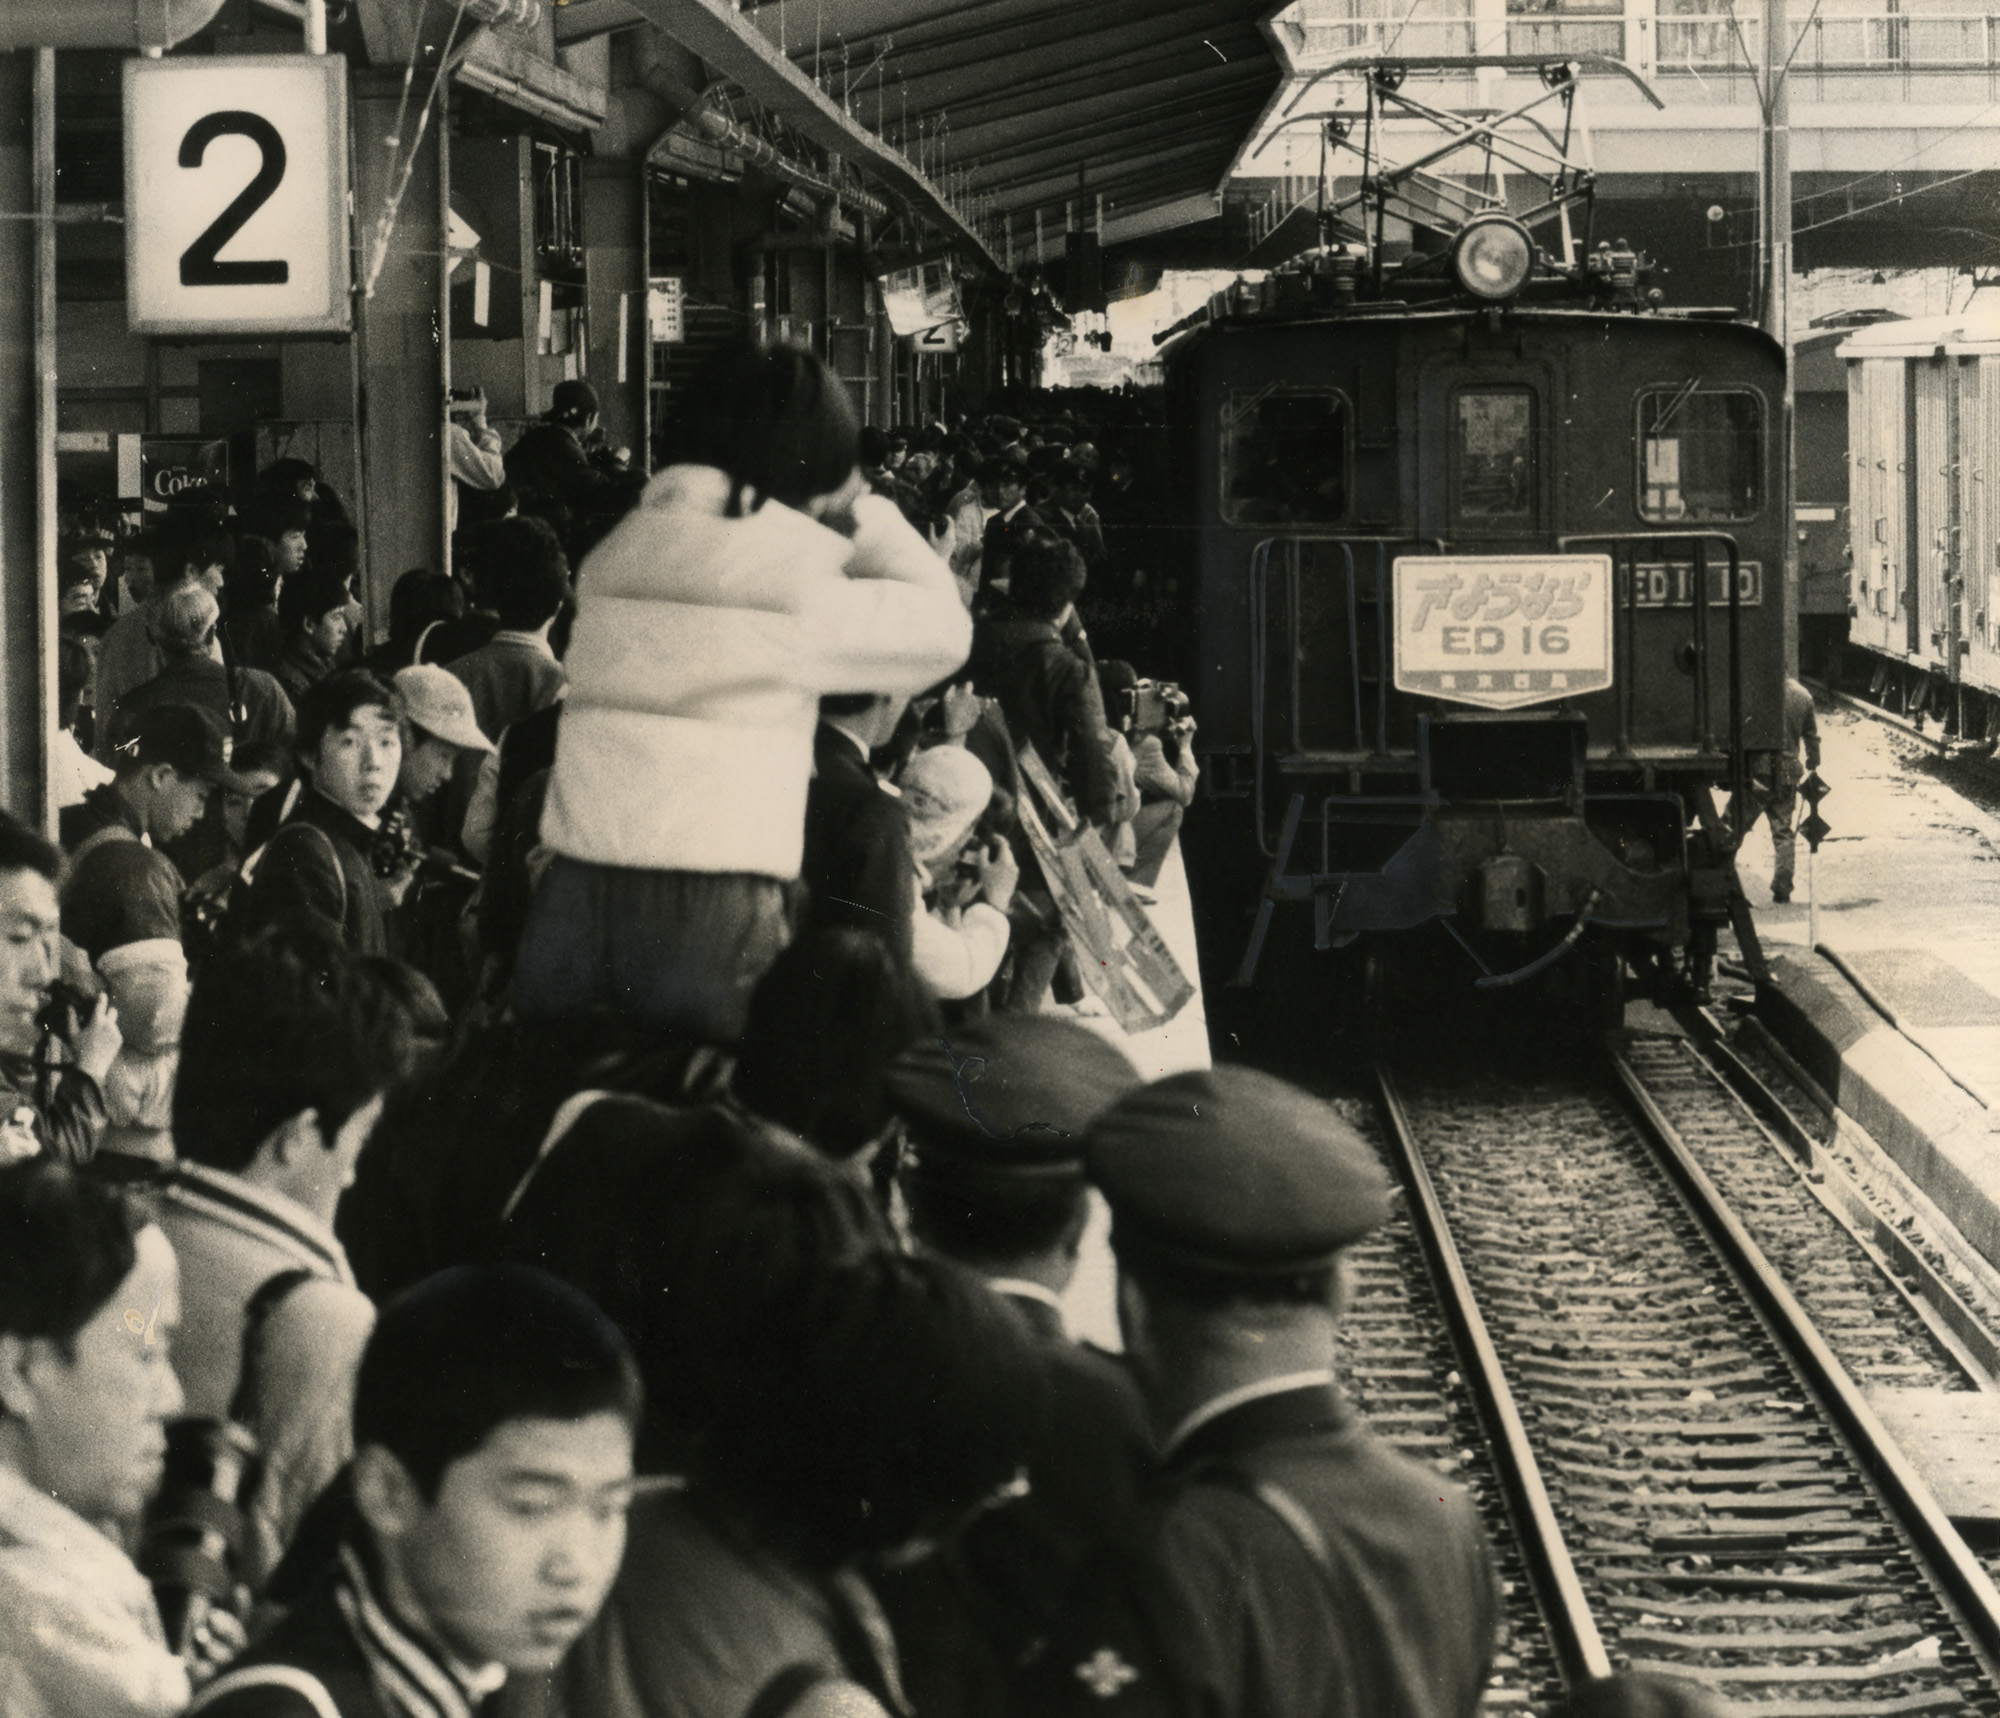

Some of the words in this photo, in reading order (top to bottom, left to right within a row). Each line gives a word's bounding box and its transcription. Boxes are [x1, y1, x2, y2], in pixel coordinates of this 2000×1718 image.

[178, 111, 288, 286] 2
[1411, 572, 1592, 633] さようなら
[1441, 625, 1505, 655] ED
[1522, 625, 1570, 655] 16
